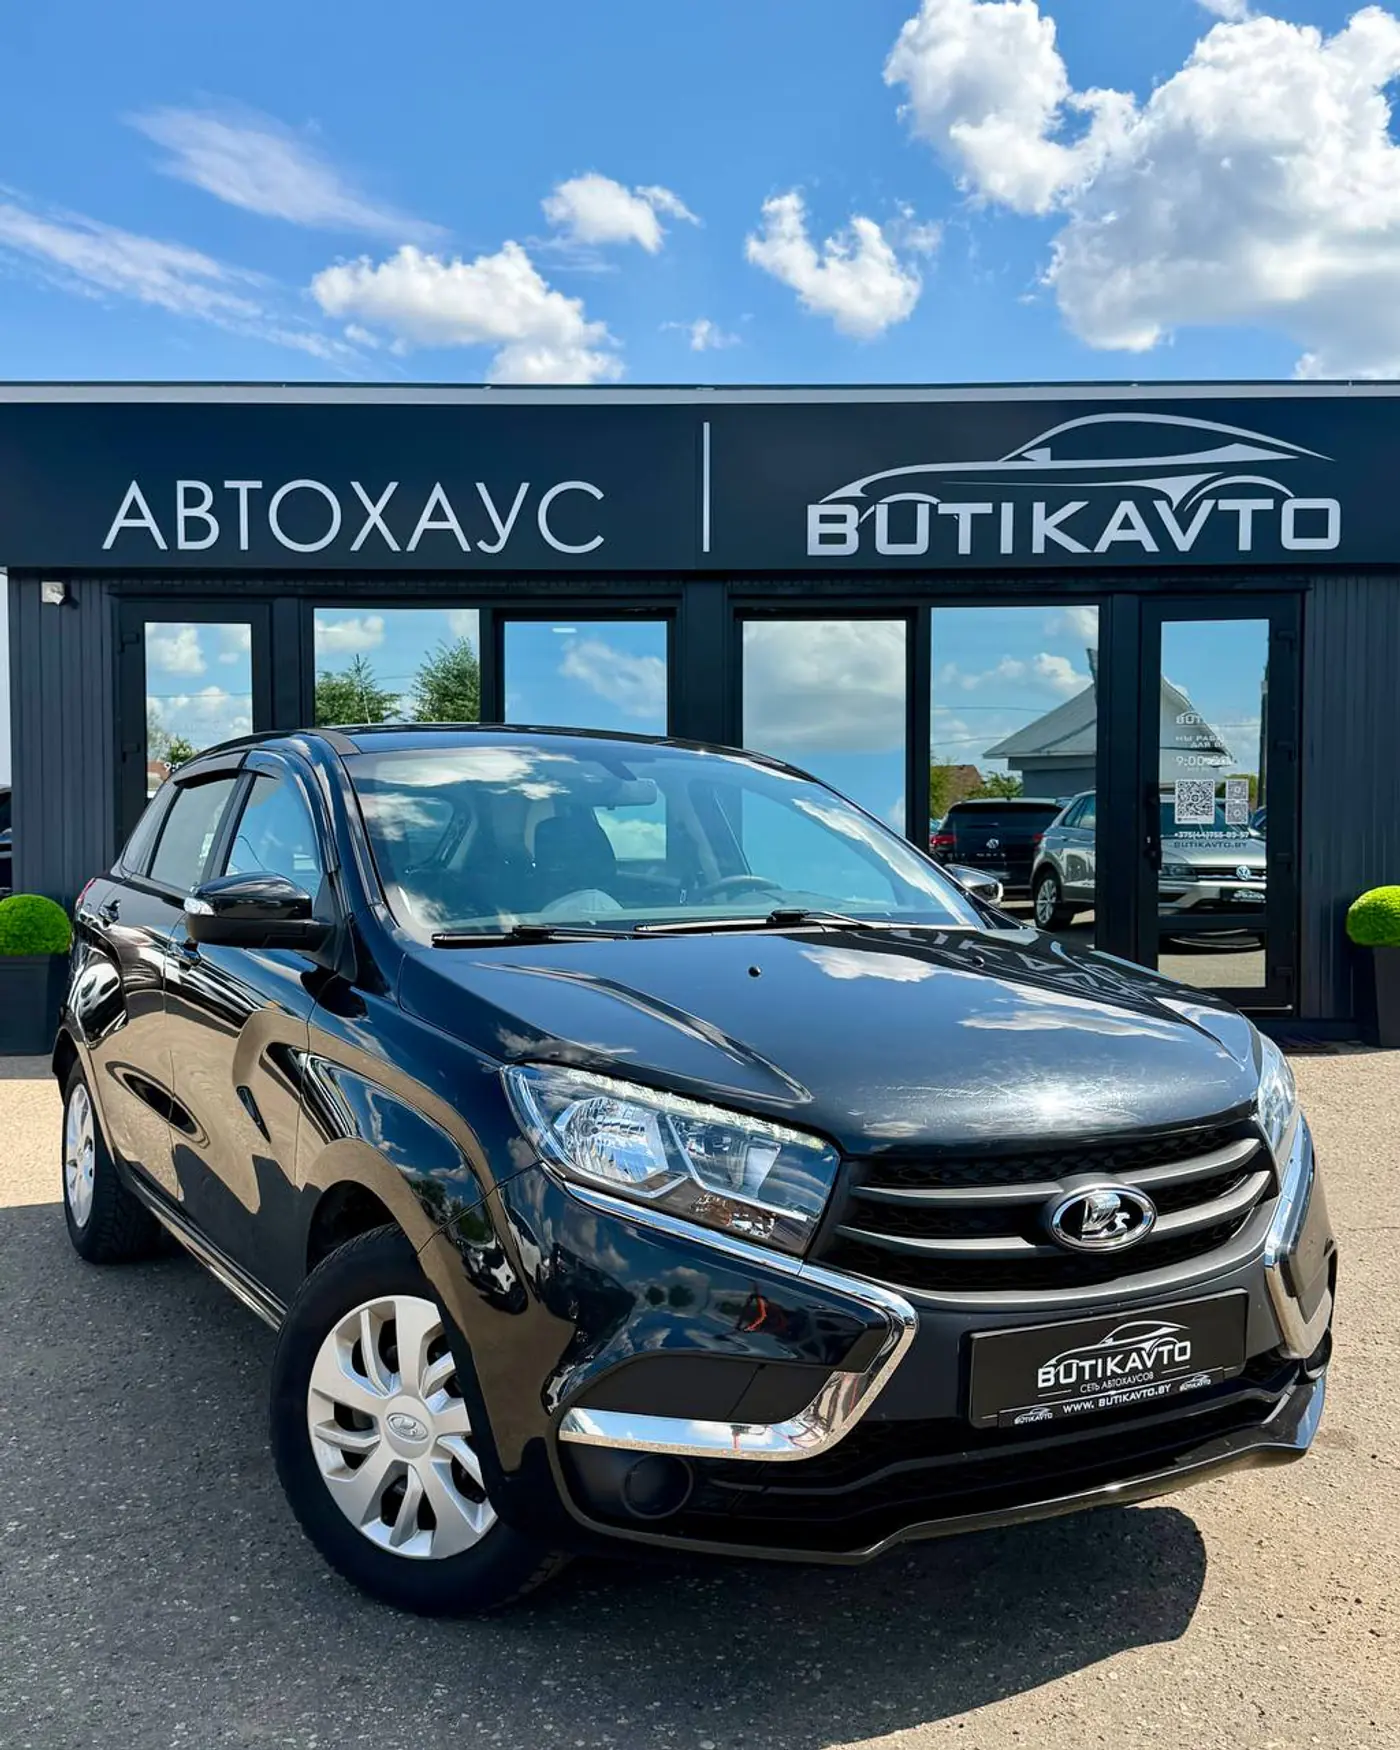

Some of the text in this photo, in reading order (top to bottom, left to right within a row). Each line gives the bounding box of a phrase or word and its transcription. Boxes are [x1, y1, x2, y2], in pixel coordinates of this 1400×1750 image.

[102, 479, 605, 554] АВТОХАУС
[806, 496, 1341, 556] BUTIKAVTO
[1037, 1341, 1191, 1389] BUTIKAVTO
[1079, 1371, 1154, 1393] СЕТЬ АВТОХАУСОВ
[1062, 1383, 1172, 1414] WWW. BUTIKAVTO.BY
